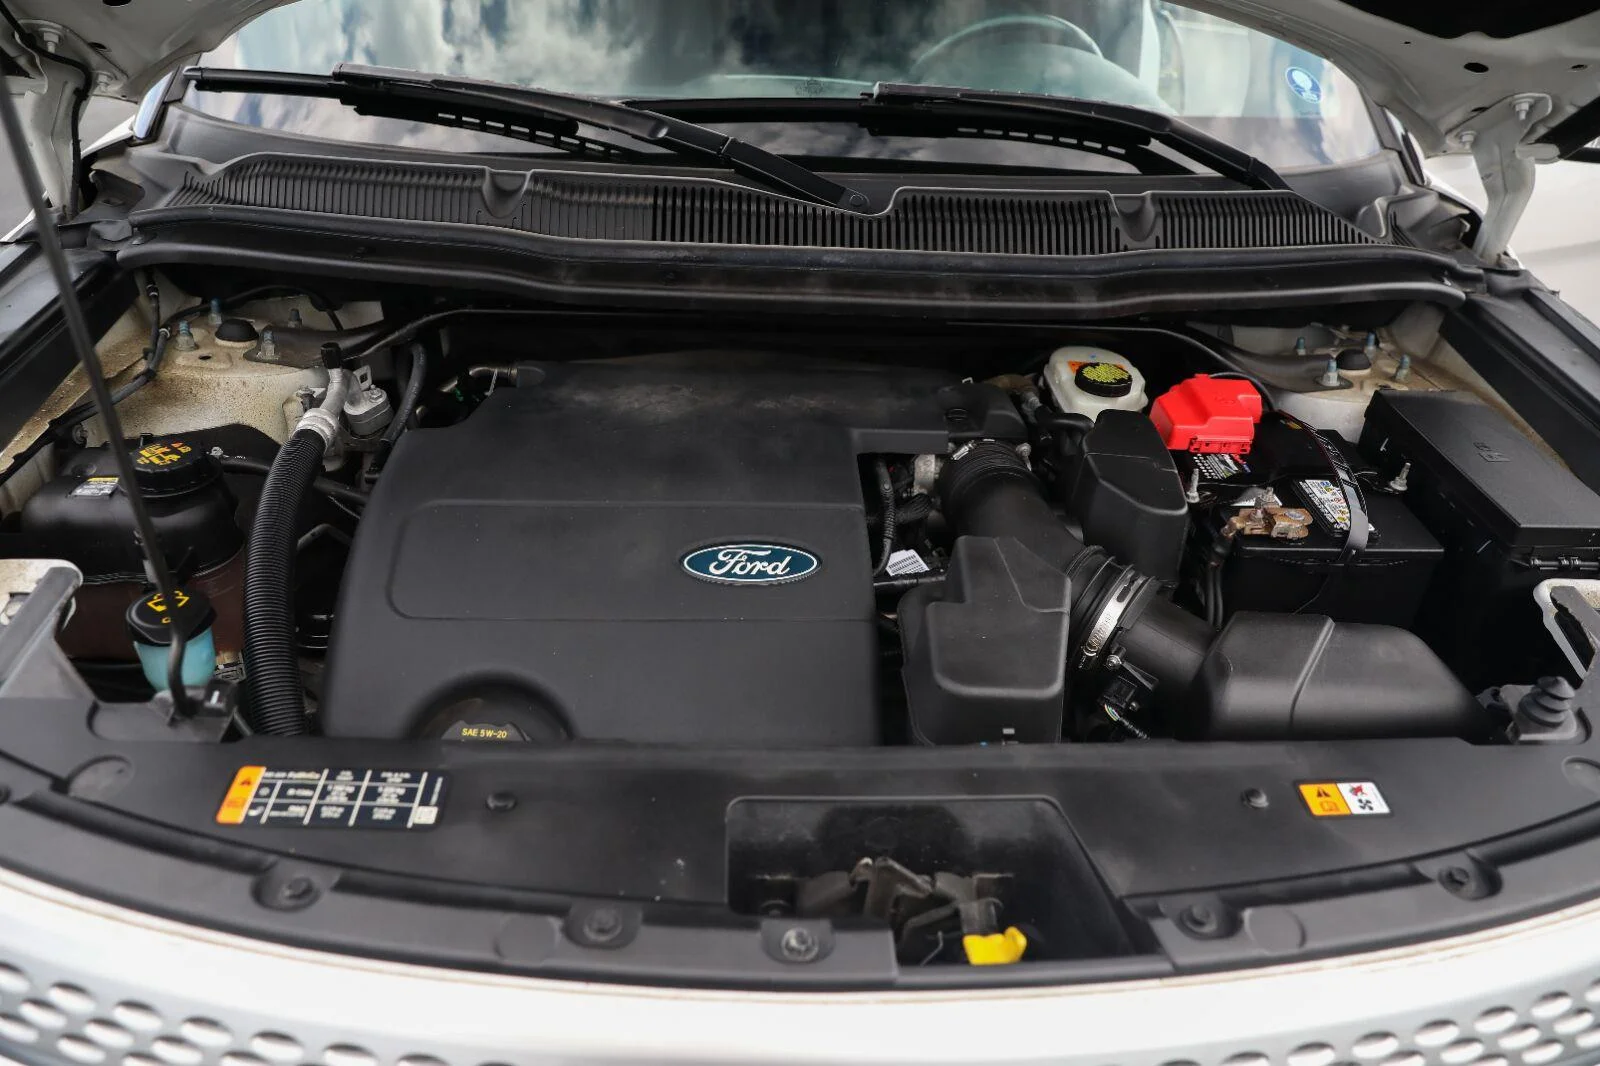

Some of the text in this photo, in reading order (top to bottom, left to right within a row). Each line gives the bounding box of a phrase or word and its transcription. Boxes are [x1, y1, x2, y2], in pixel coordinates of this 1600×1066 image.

[709, 549, 792, 575] Ford
[461, 728, 508, 739] SAE 5W-20
